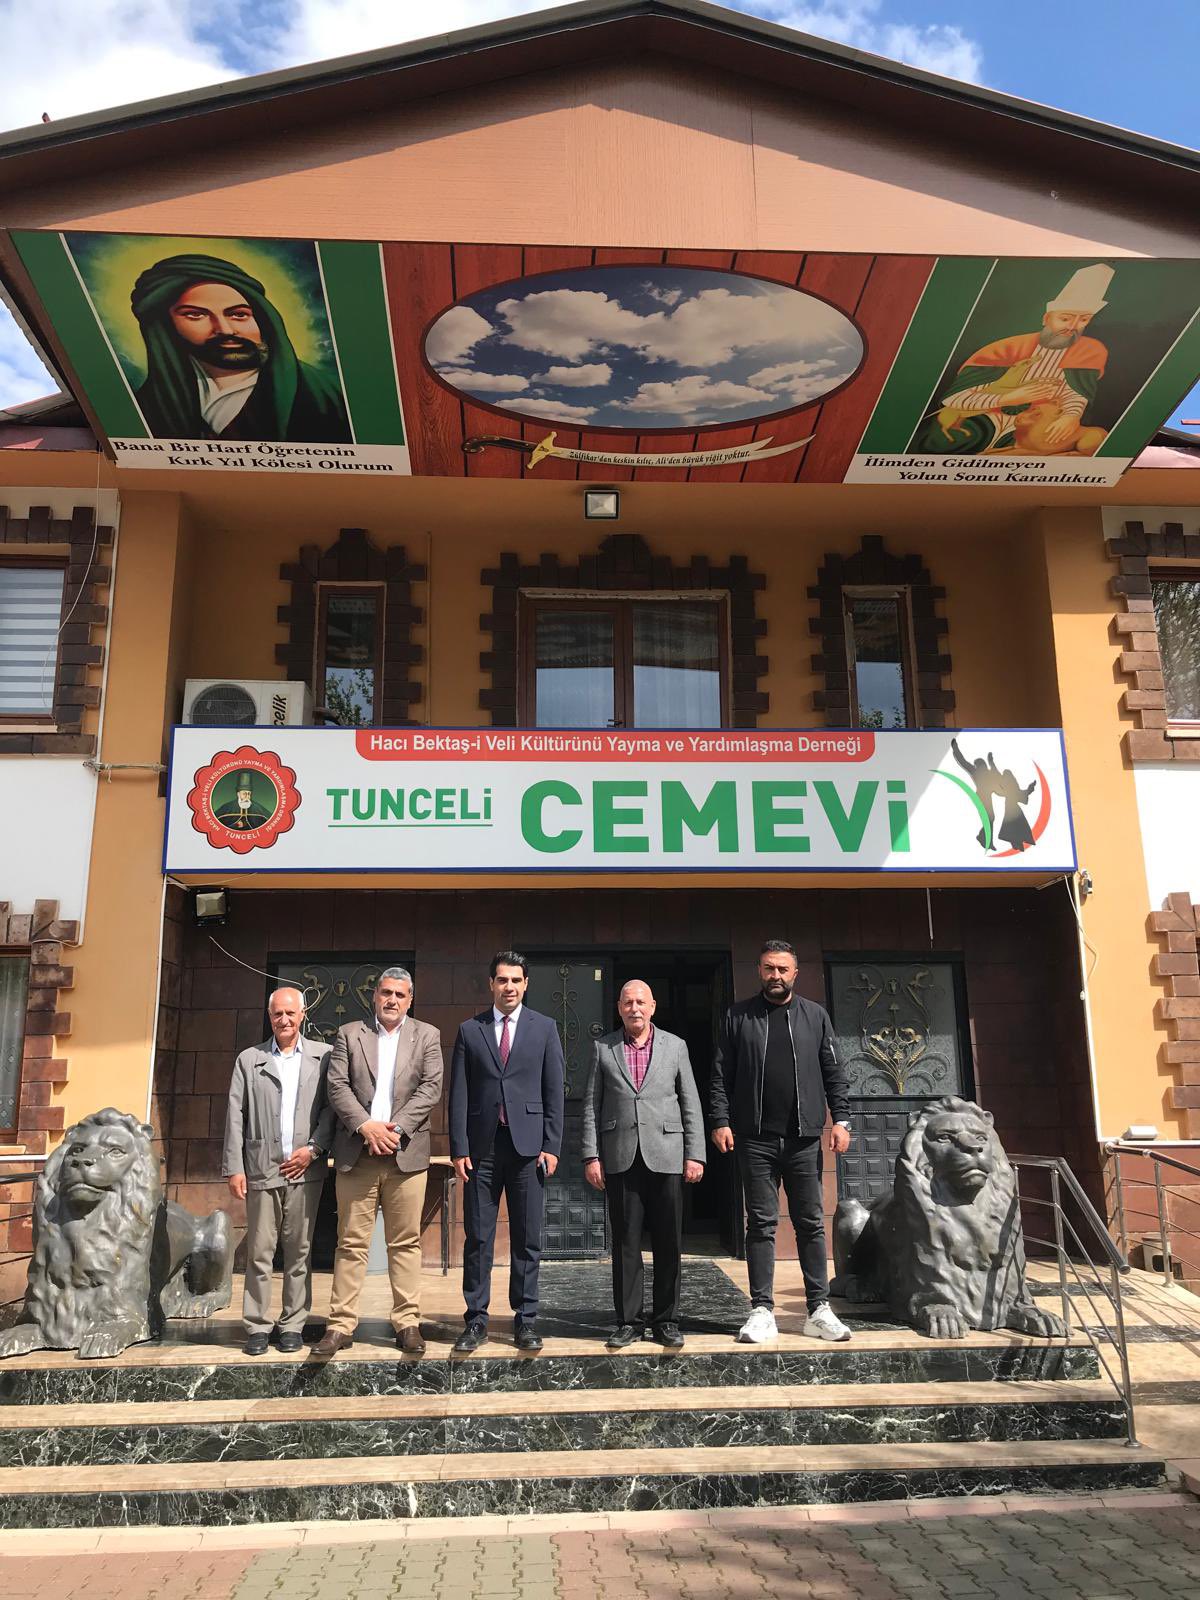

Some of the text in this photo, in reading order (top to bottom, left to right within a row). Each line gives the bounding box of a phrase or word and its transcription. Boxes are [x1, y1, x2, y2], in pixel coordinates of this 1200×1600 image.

[113, 441, 356, 458] Bana Bir Harf Öğretenin
[168, 456, 393, 471] Kırk Yıl Kölesi Olurum
[569, 451, 611, 463] Zülfikar'dan
[613, 456, 635, 464] keskin
[705, 454, 722, 464] yiğit
[722, 450, 750, 463] yoktur.
[864, 455, 1046, 470] İlimden Gidilmeyen
[898, 472, 1107, 484] Yolun Sonu Karanlıktır.
[371, 734, 861, 756] Hacı Bektaş-i Veli Kültürünü Yayma ve Yardımlaşma Derneği
[244, 760, 263, 768] YAYMA
[224, 831, 260, 840] TUNCELİ
